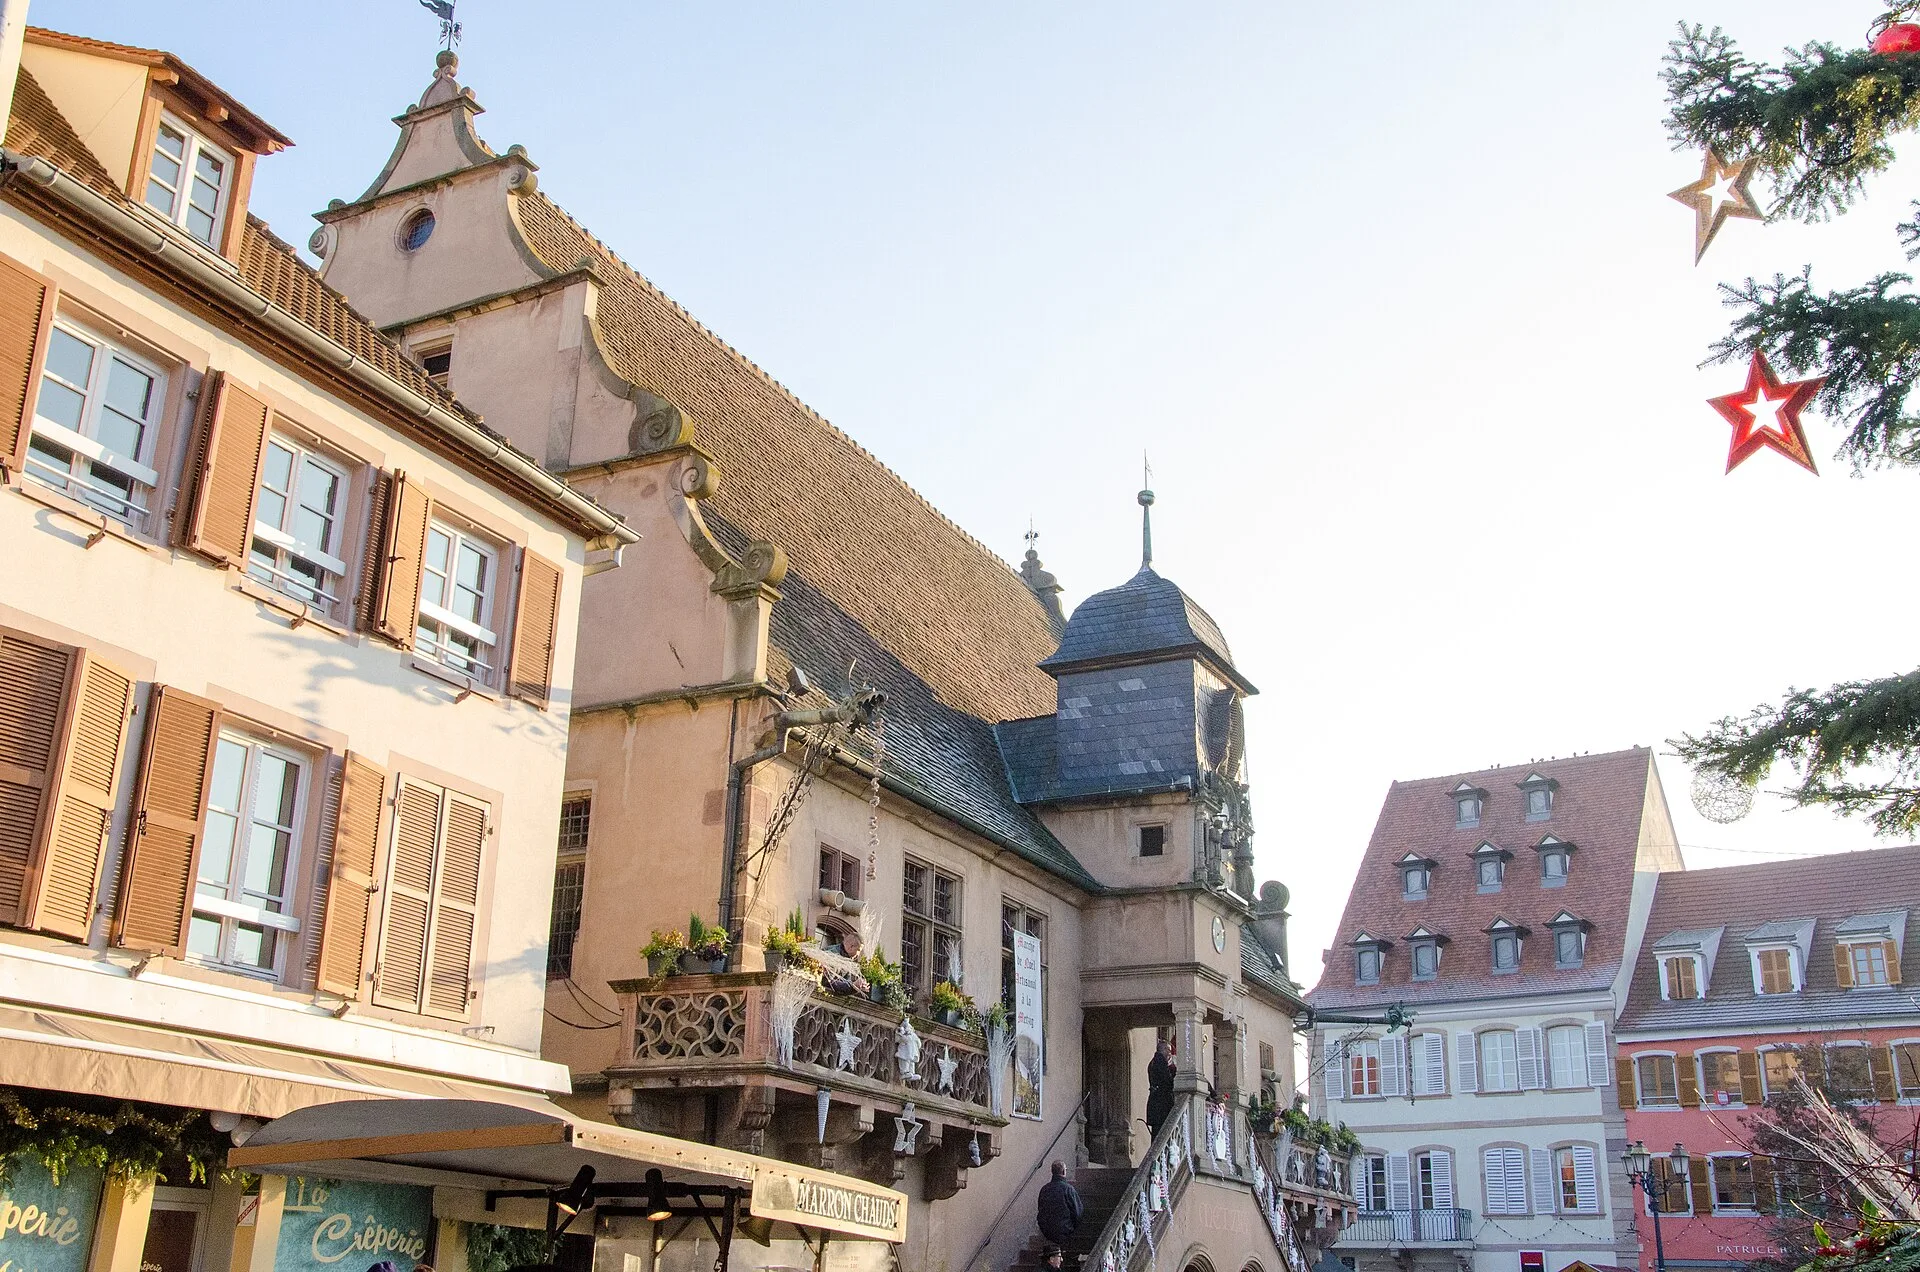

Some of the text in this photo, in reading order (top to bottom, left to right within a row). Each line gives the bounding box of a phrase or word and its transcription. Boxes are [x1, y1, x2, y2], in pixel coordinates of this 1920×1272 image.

[284, 1176, 330, 1213] La
[797, 1183, 895, 1228] MARRON CHAUDS
[312, 1213, 426, 1263] Crêperie
[1716, 1245, 1774, 1254] PATRICE
